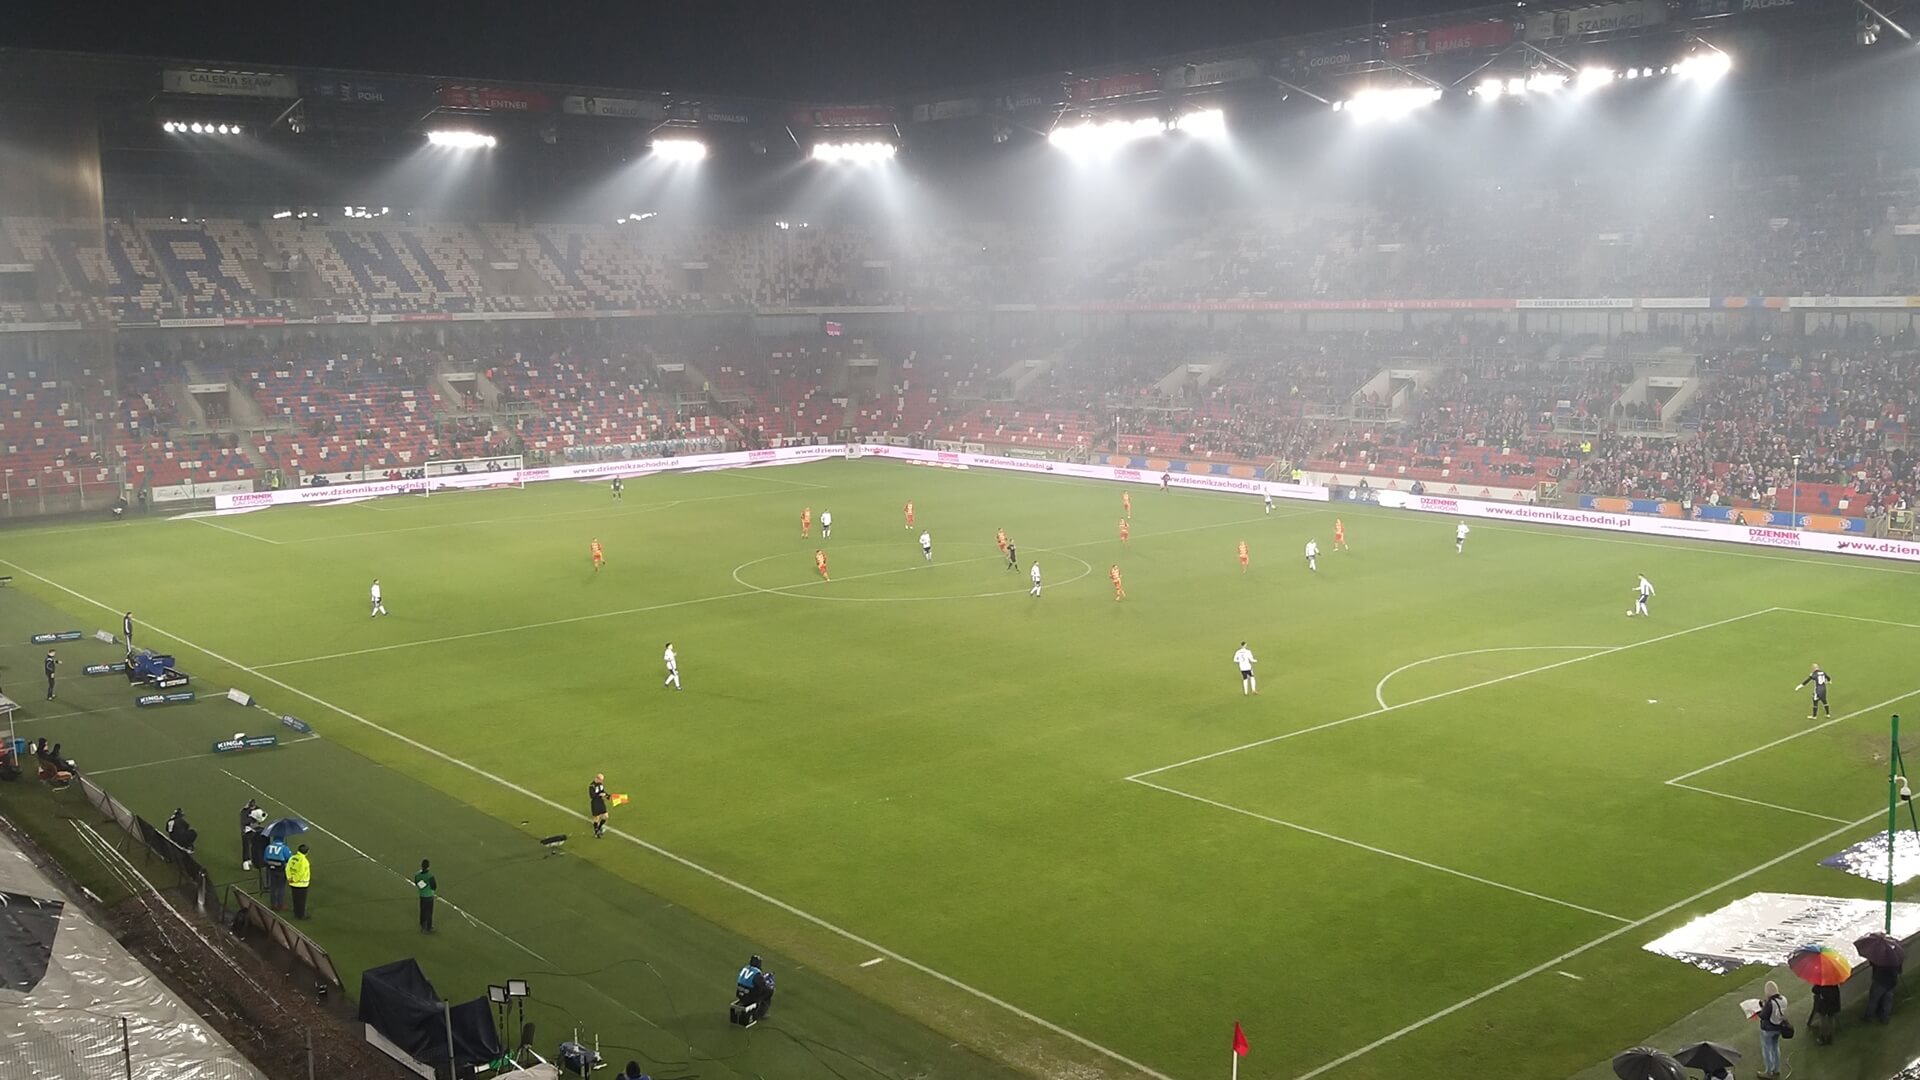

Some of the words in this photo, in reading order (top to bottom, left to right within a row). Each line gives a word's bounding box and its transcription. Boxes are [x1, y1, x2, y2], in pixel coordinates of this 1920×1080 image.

[190, 73, 237, 85] GALERIA
[357, 92, 385, 102] POHL
[486, 99, 528, 109] LENTNER
[573, 460, 679, 475] www.dziennikzachodni.pl
[301, 480, 431, 499] www.dziennikzachodni.pl
[232, 493, 273, 502] DZIENNIK
[1420, 497, 1458, 506] DZIENNIK
[232, 499, 274, 507] ZACHODNI
[1421, 503, 1459, 512] ZACHODNI
[1485, 505, 1631, 528] www.dziennikzachodni.pl
[1749, 528, 1800, 541] DZIENNIK
[1749, 535, 1801, 547] ZACHODNI
[87, 664, 110, 672] KINGA
[140, 695, 164, 703] KINGA
[217, 740, 244, 749] KINGA
[267, 844, 282, 855] TV
[739, 967, 754, 980] TV
